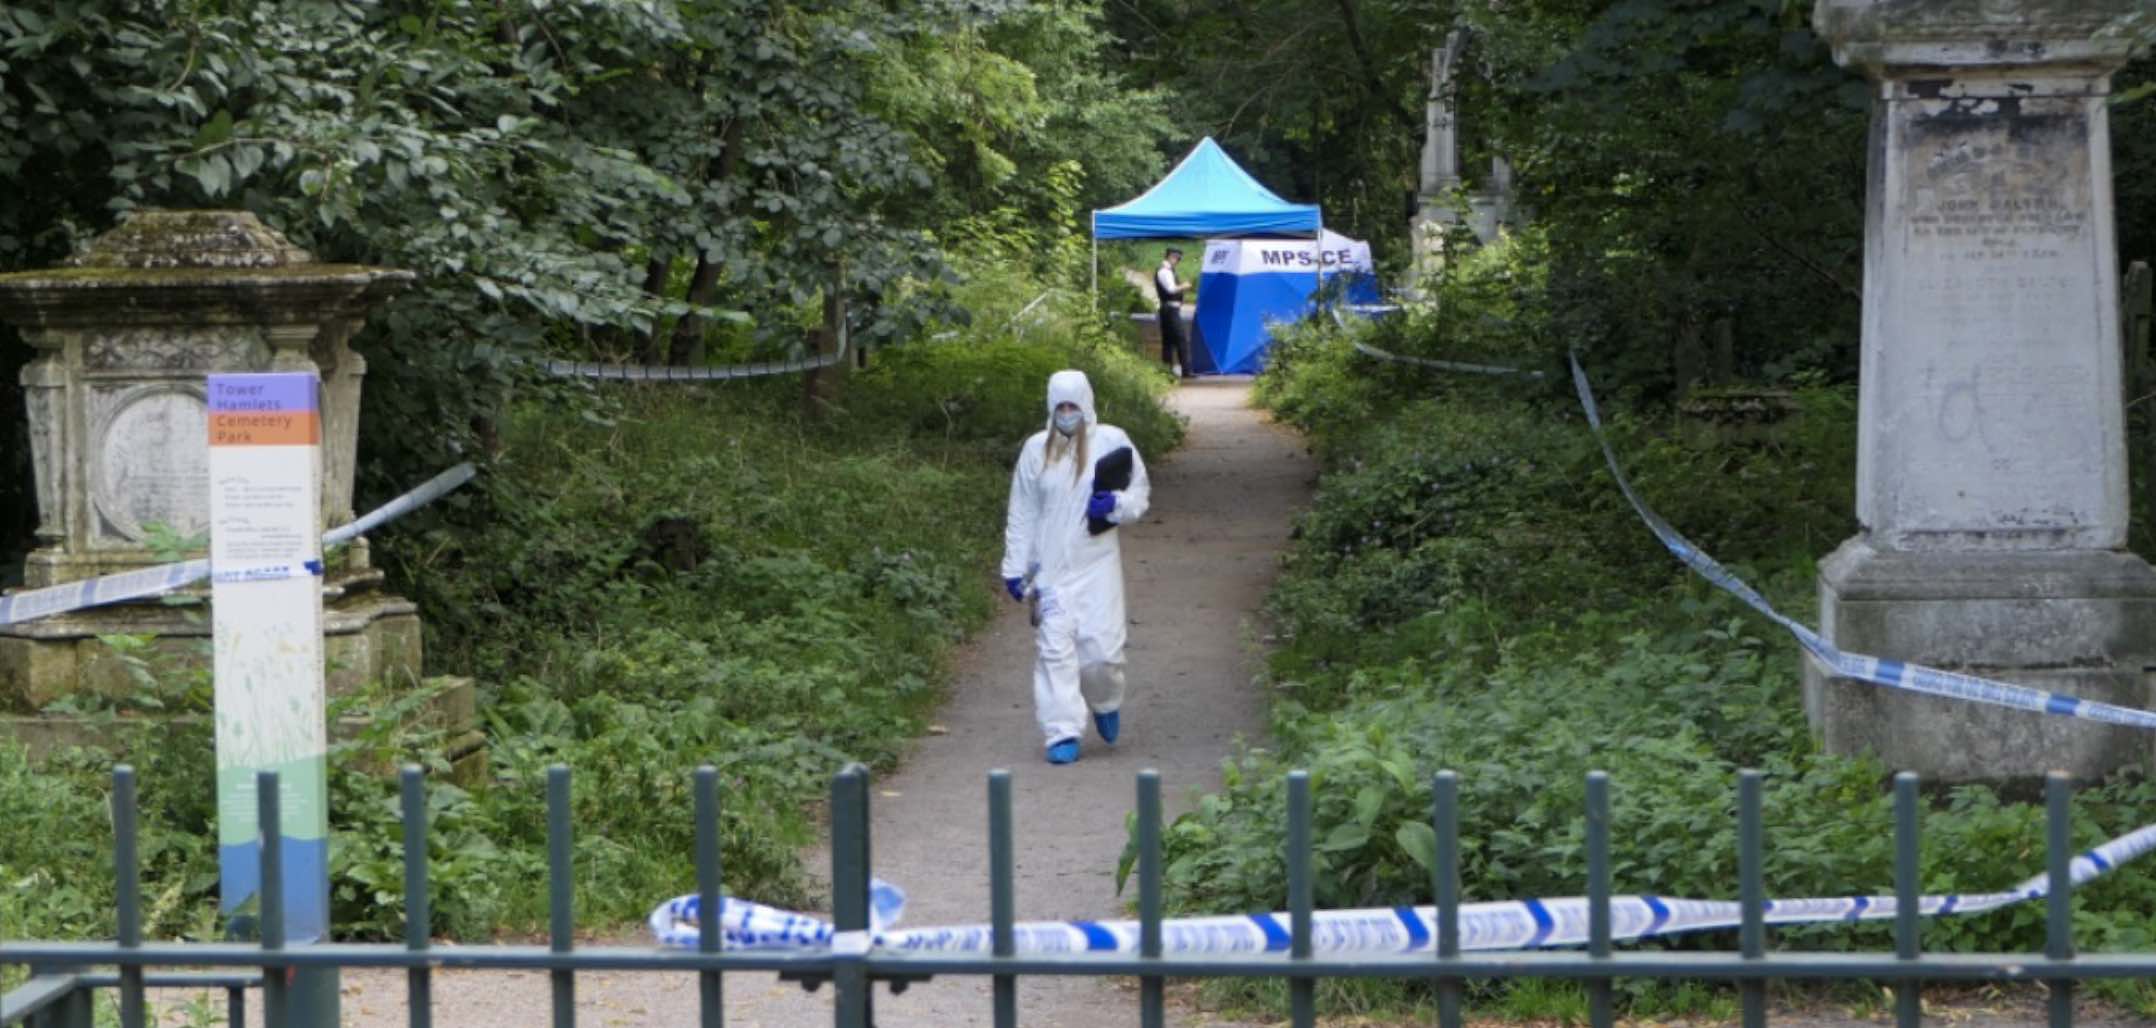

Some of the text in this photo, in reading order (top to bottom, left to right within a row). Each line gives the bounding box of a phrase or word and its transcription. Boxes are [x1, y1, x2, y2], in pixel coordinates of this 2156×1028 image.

[216, 383, 265, 396] Tower
[216, 398, 282, 411] Hamlets
[216, 414, 293, 430] Cemetery
[216, 430, 252, 443] Park
